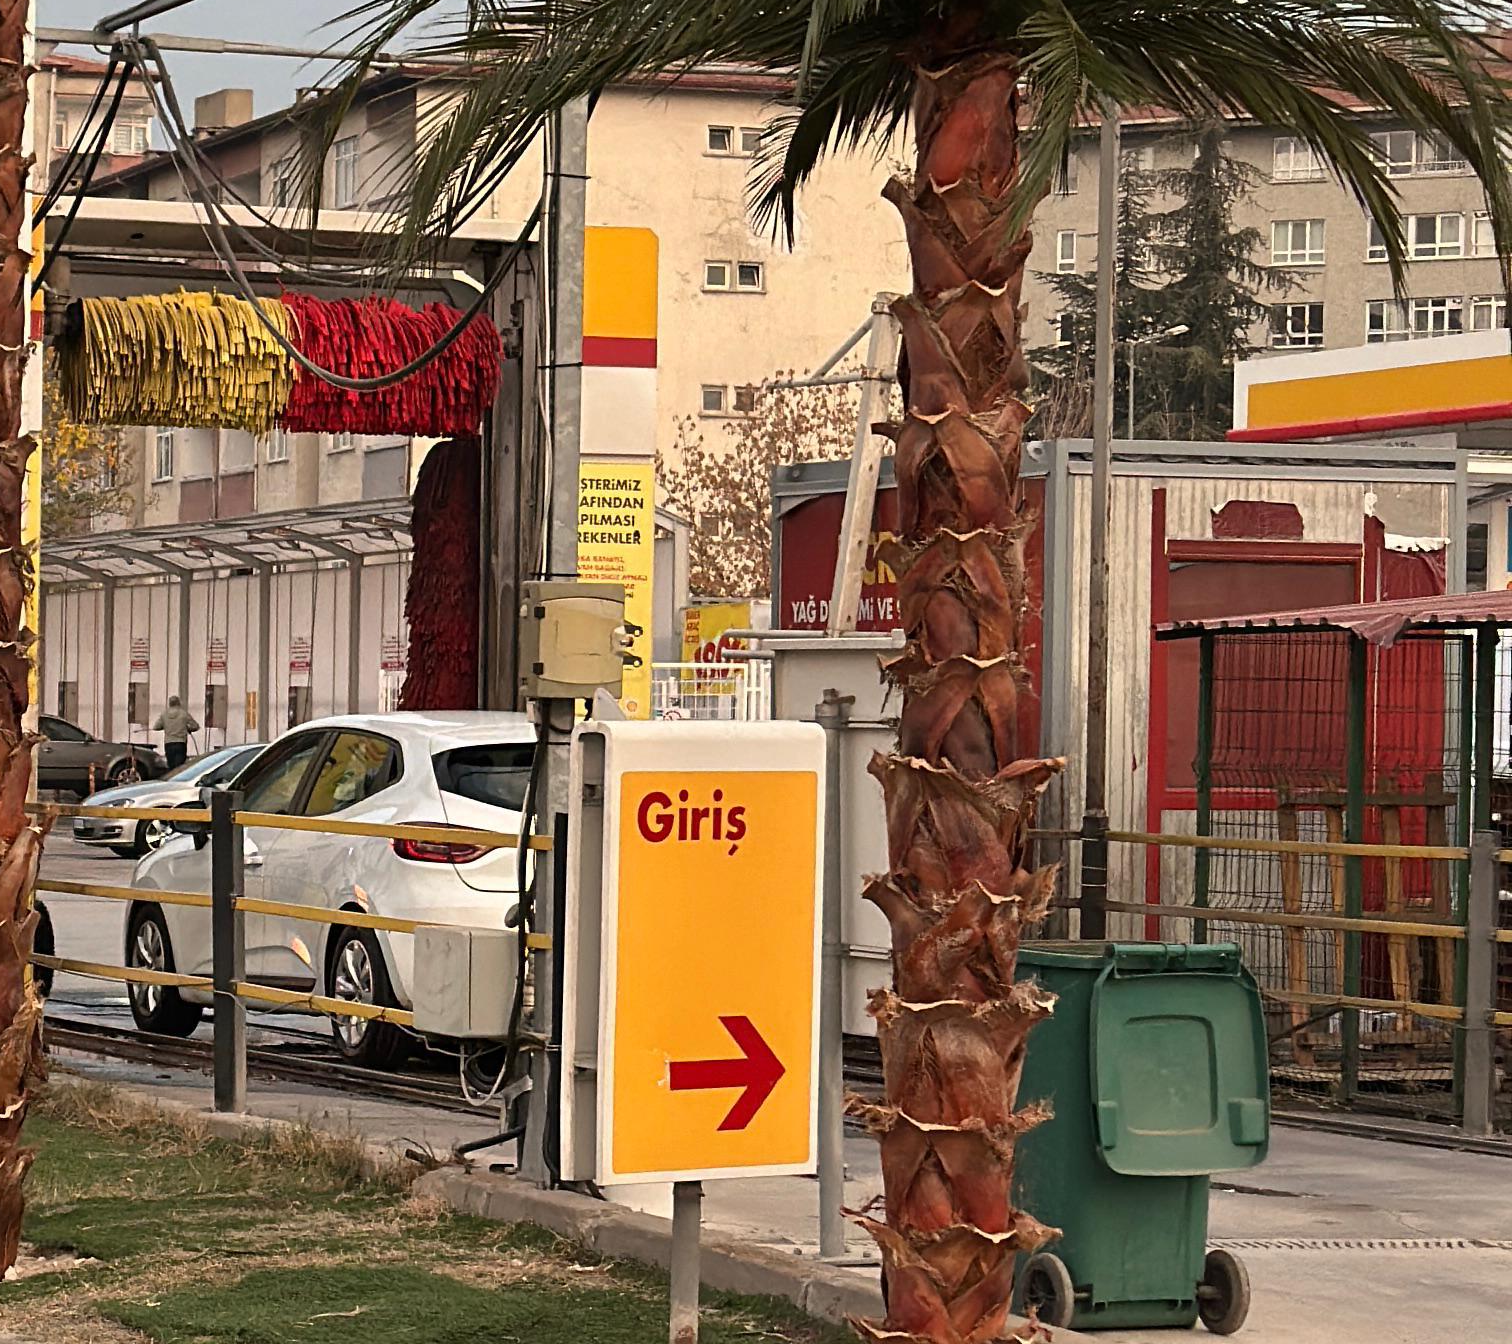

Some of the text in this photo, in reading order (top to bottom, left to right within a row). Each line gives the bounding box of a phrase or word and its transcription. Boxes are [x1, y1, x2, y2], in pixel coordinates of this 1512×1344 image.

[579, 496, 643, 509] AFINDAN
[578, 514, 635, 527] PILMASI
[791, 594, 817, 624] YAĞ
[877, 597, 894, 620] VE
[637, 789, 747, 856] Giriş
